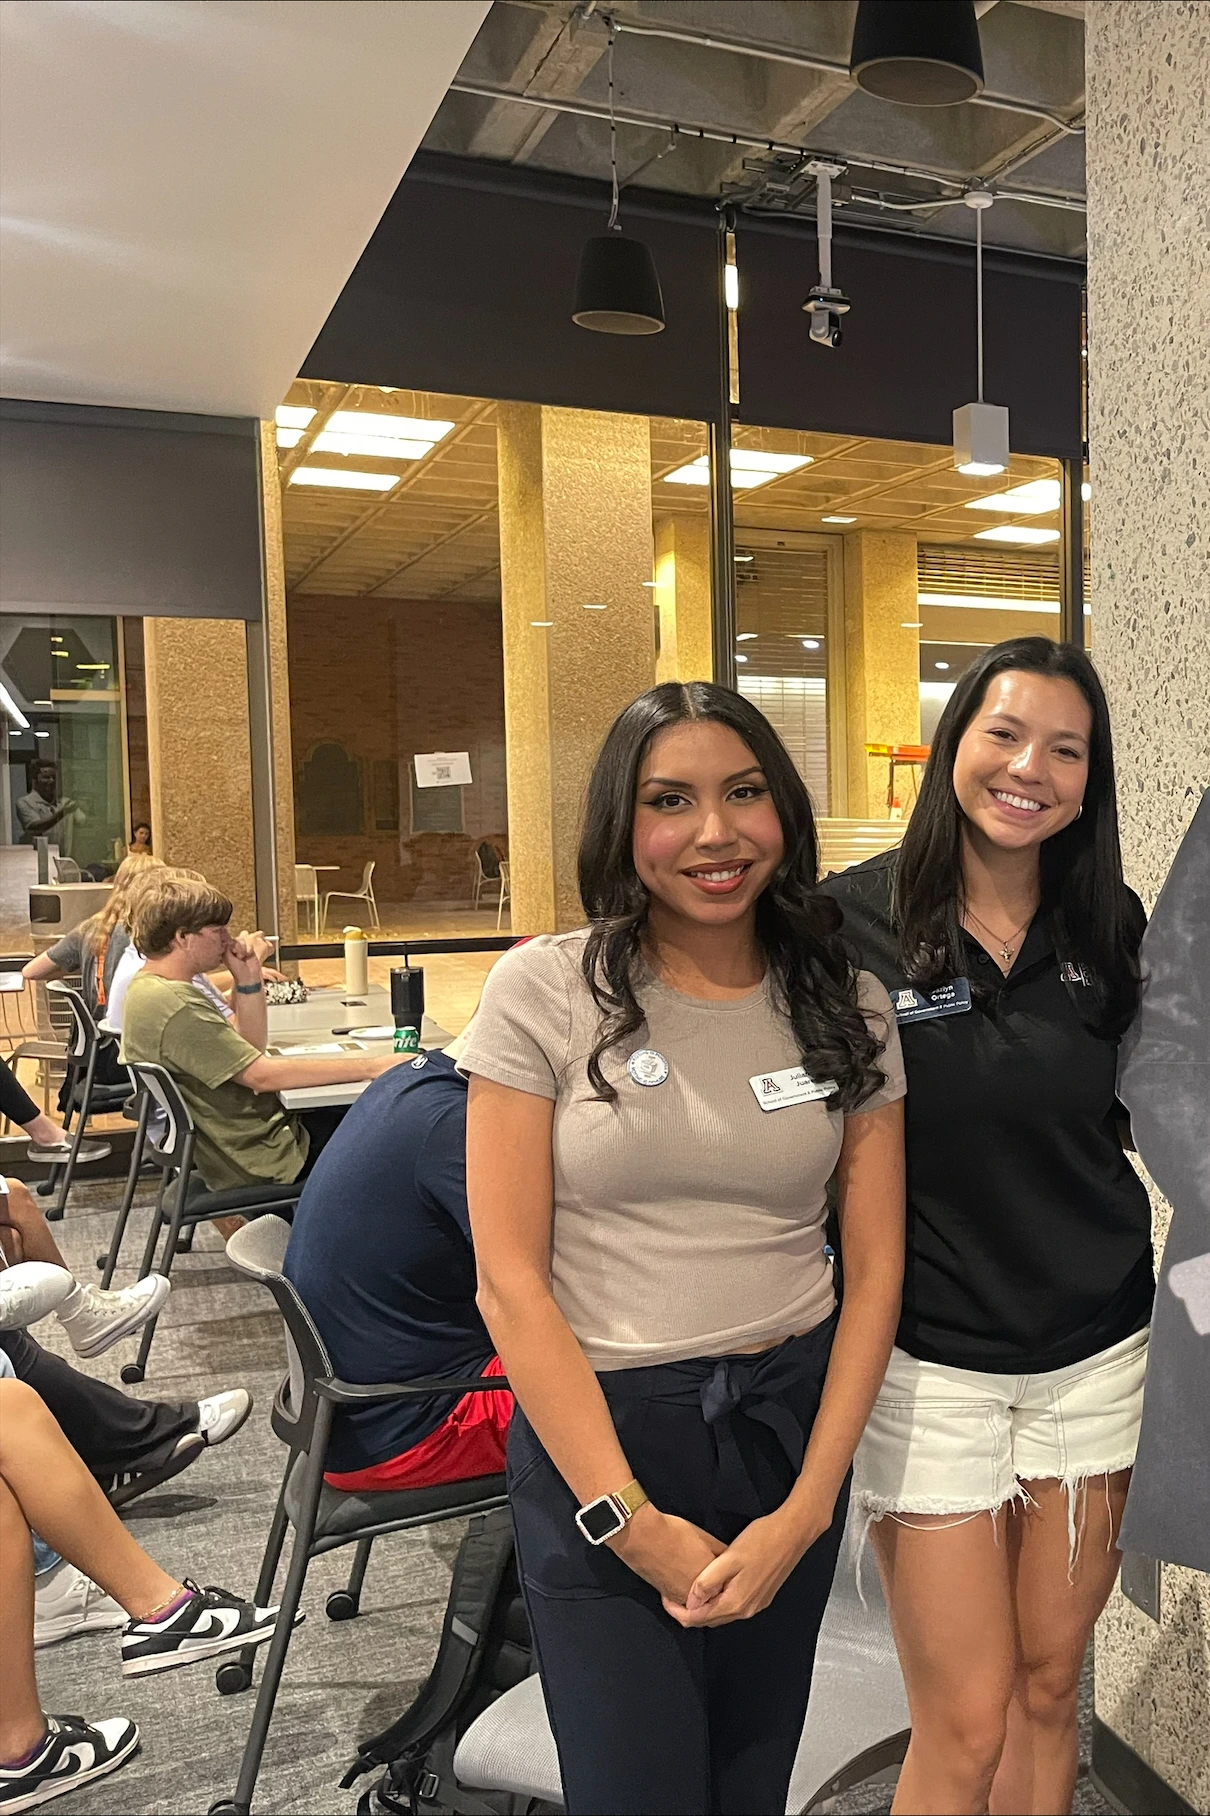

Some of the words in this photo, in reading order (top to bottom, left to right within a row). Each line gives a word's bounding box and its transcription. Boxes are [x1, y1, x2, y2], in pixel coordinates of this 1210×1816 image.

[896, 989, 918, 1010] A
[931, 992, 955, 1001] Ortega
[394, 1034, 417, 1048] rite
[761, 1078, 781, 1094] A
